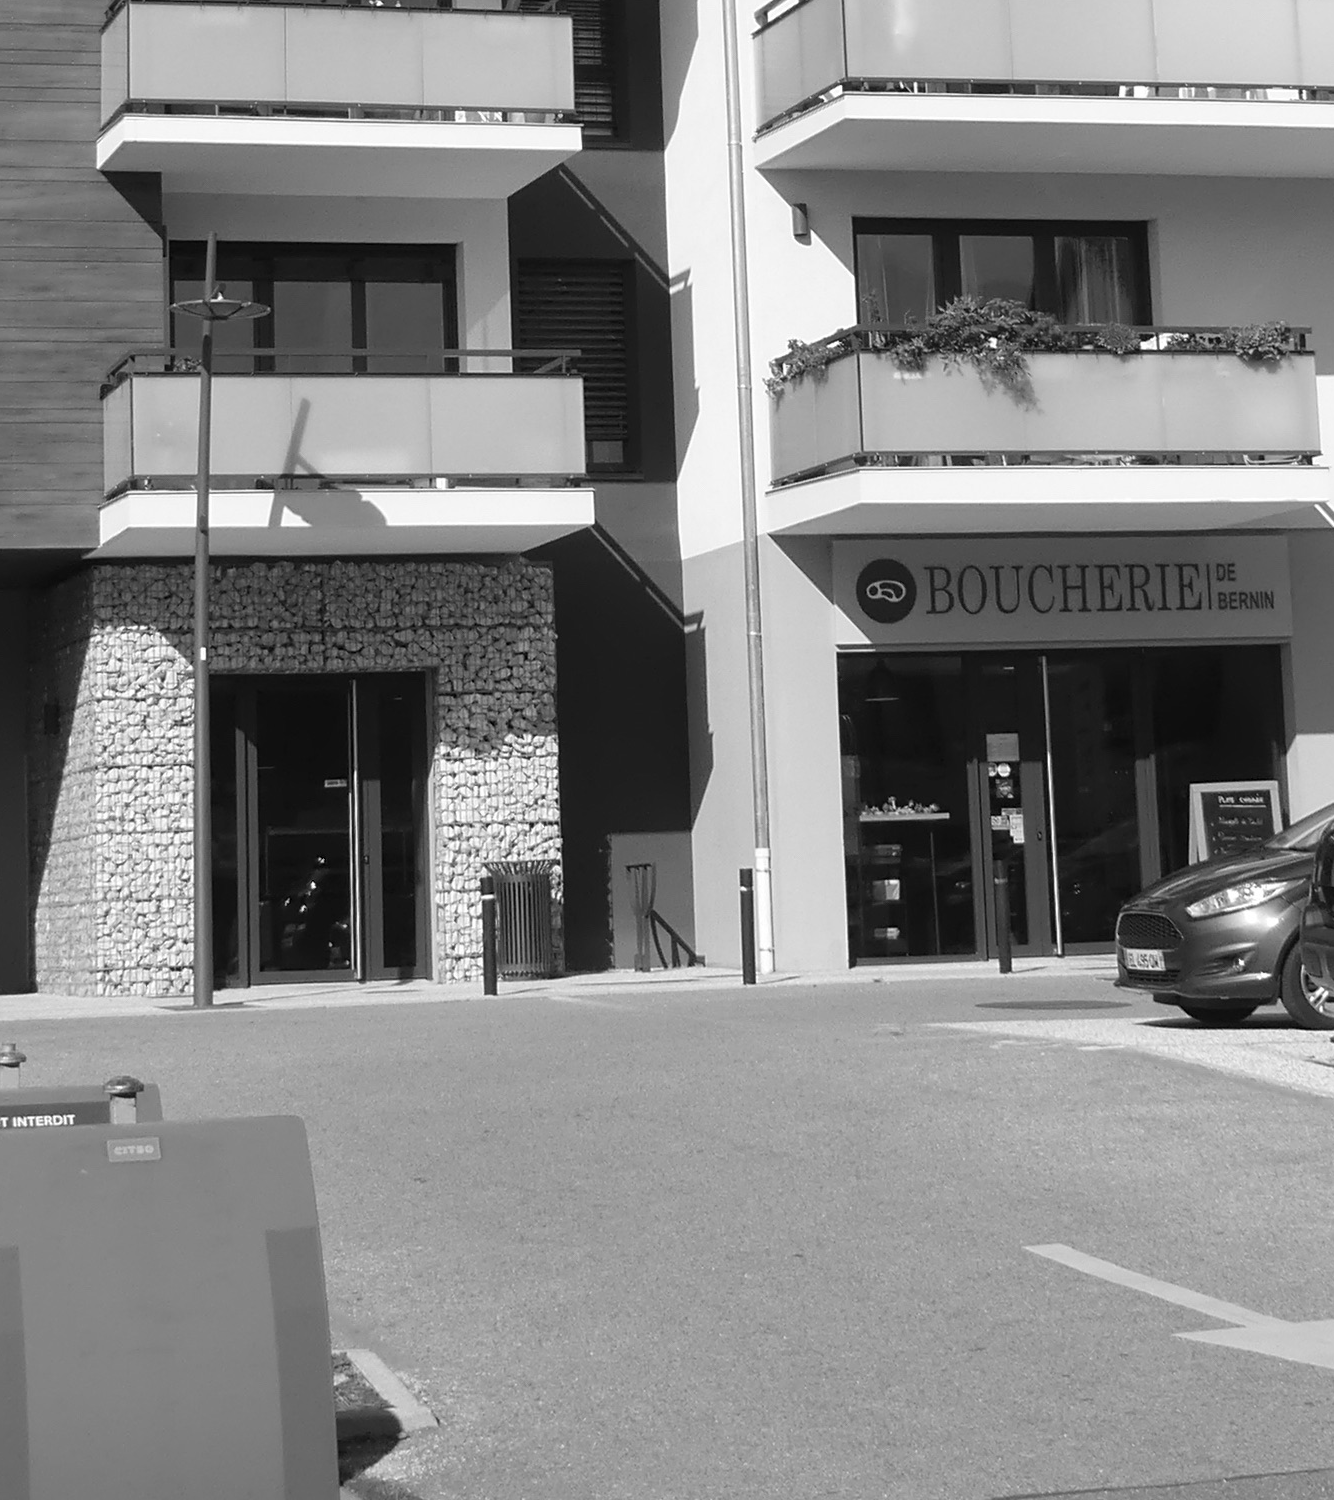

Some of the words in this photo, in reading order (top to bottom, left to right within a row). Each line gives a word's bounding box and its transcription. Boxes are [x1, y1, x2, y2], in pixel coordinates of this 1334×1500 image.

[1216, 562, 1237, 583] DE
[923, 563, 1202, 615] BOUCHERIE
[1217, 590, 1275, 610] BERNIN
[12, 1113, 76, 1128] INTERDIT
